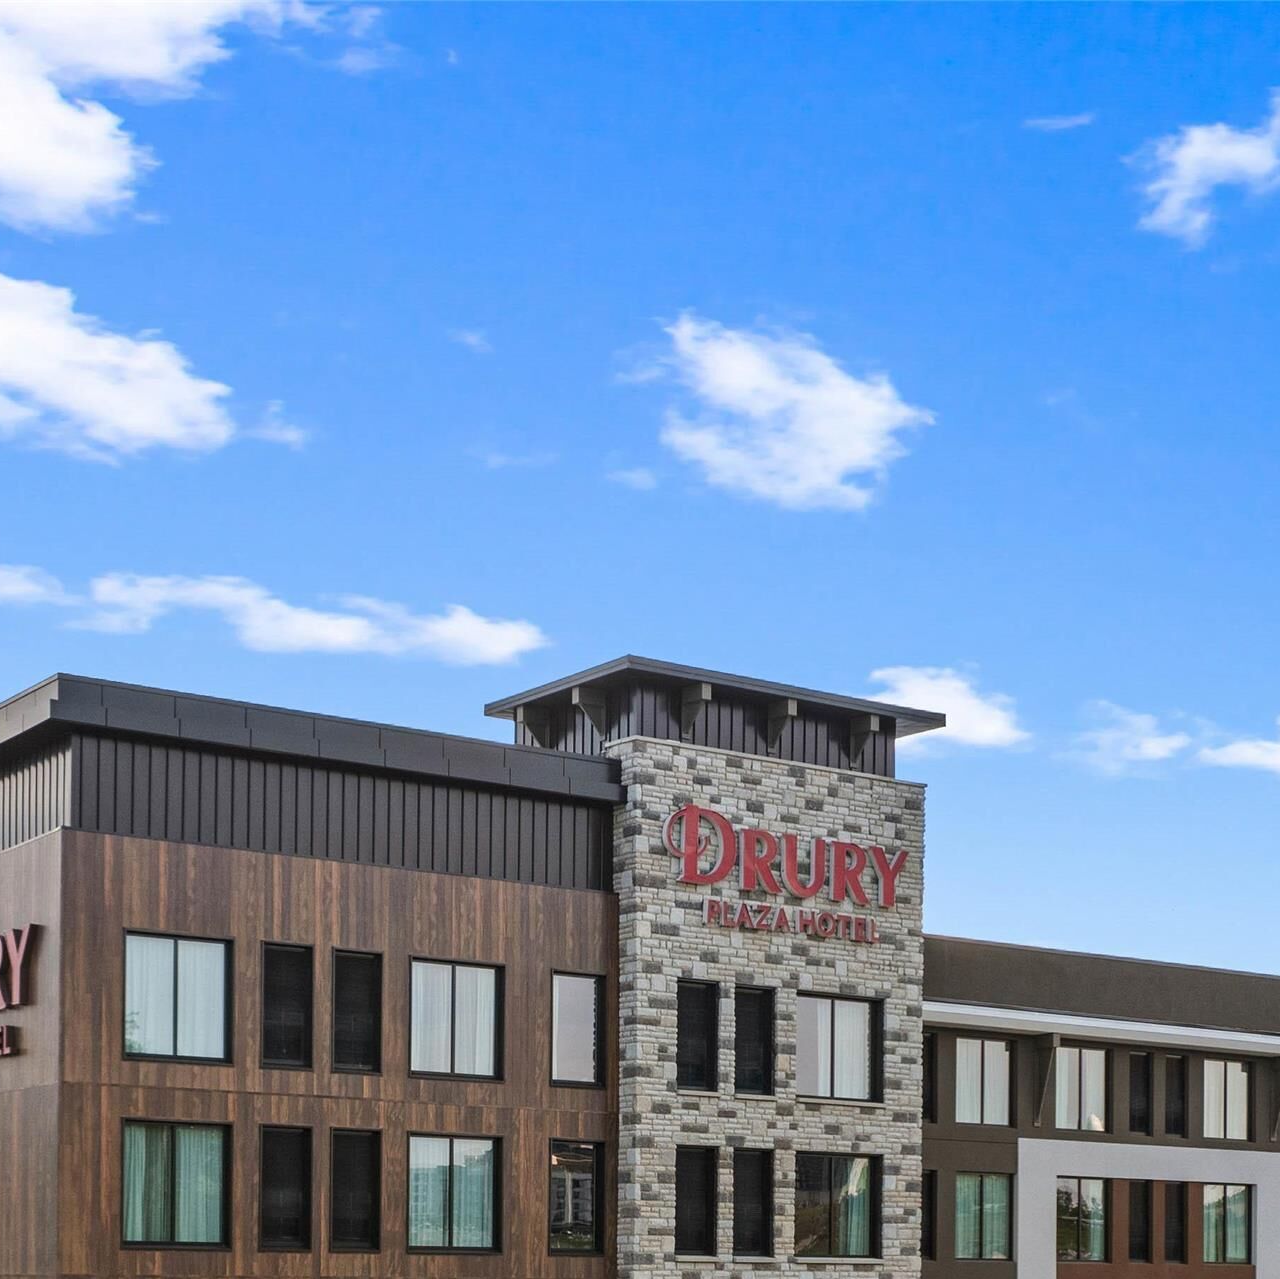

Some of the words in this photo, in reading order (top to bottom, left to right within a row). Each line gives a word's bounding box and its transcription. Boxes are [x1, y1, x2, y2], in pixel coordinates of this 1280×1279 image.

[662, 803, 909, 908] DRURY
[704, 898, 791, 933] PLAZA
[794, 908, 881, 944] HOTEL
